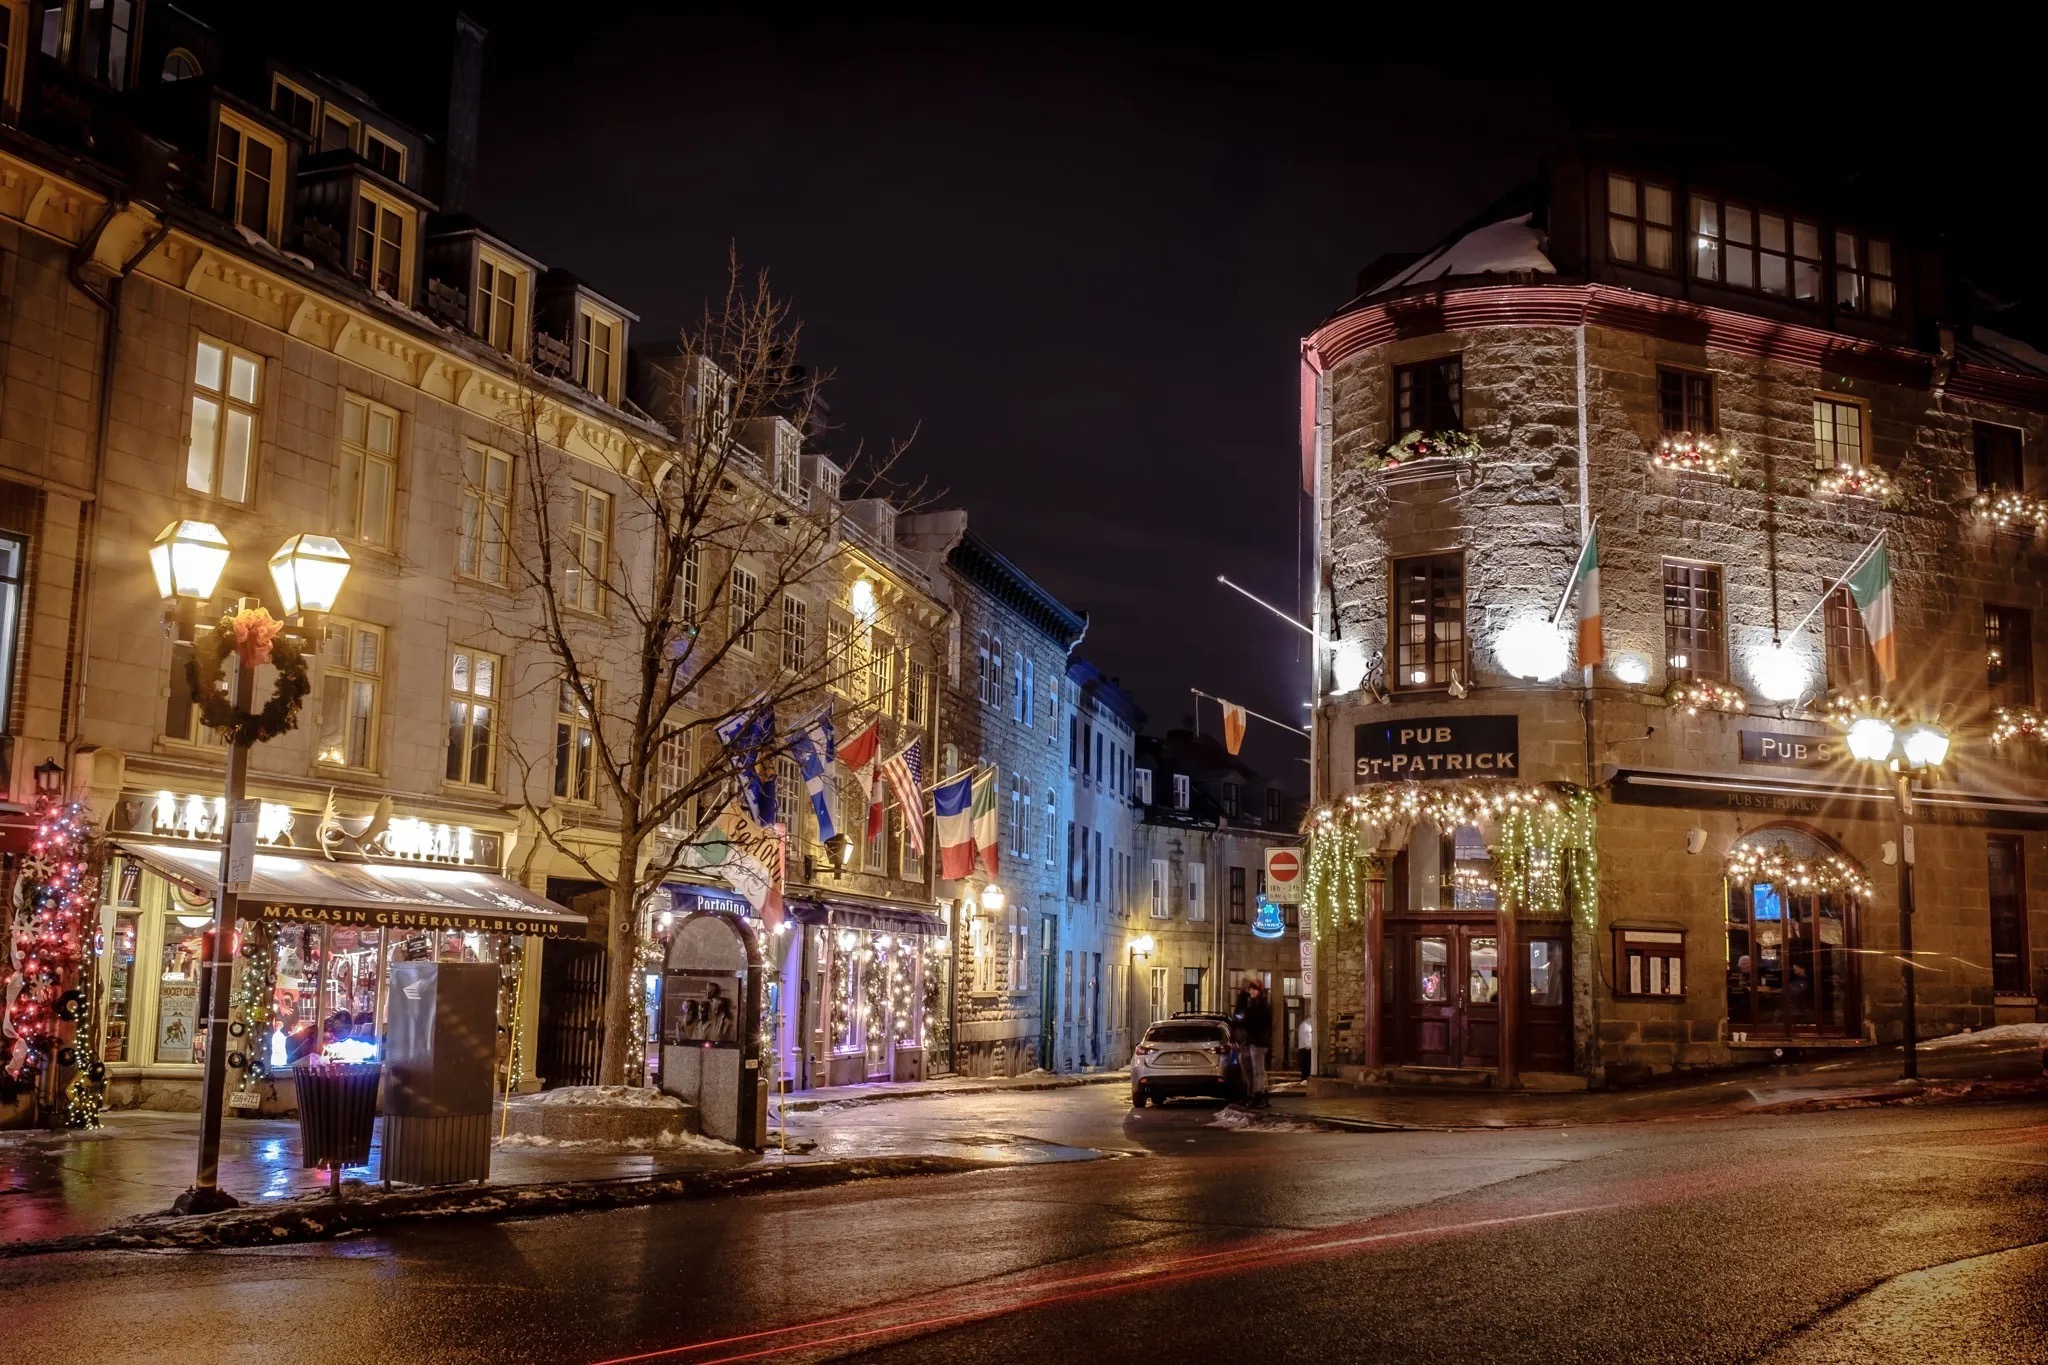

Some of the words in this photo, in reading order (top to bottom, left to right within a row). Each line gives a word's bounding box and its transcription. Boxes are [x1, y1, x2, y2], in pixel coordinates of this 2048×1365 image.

[1400, 727, 1452, 745] PUB
[1761, 737, 1808, 760] PUB
[1356, 752, 1515, 776] ST-PATRICK
[1727, 793, 1753, 807] PUB
[1754, 795, 1818, 812] ST-PATRICK
[263, 904, 366, 923] MAGASIN
[376, 911, 463, 928] GÉNÉRAL
[697, 895, 745, 917] Portofino
[871, 916, 902, 932] Portofino
[163, 986, 183, 997] HOCKEY
[183, 987, 196, 997] CLUB
